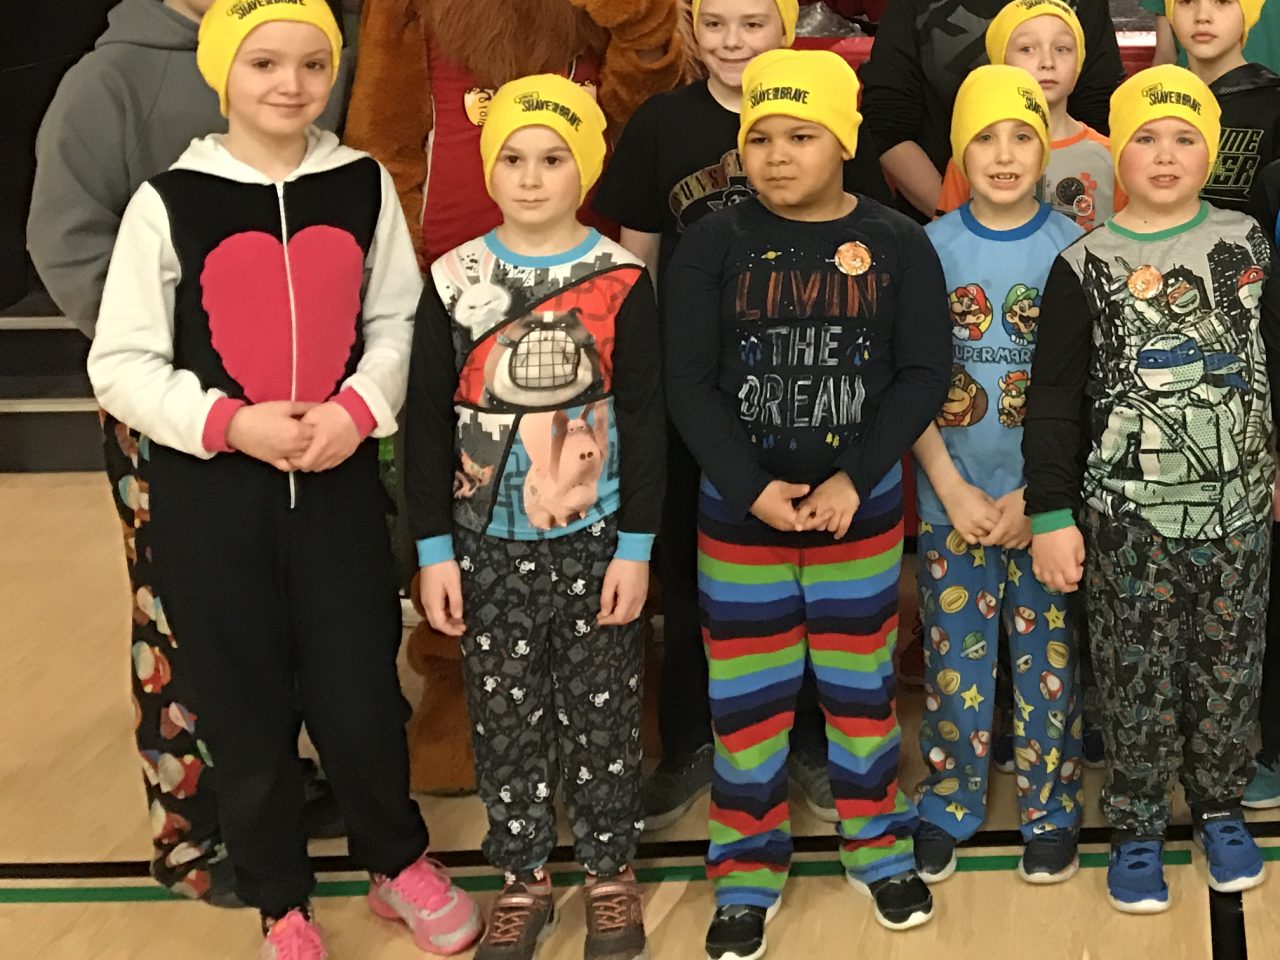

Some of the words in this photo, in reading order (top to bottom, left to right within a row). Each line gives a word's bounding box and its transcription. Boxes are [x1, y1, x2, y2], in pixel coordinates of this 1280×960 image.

[780, 86, 811, 104] BRAVE
[1149, 90, 1174, 106] SHAVE
[522, 99, 551, 112] SHAVE
[766, 325, 843, 367] THE
[954, 345, 993, 362] UPER
[995, 346, 1033, 363] MAR
[737, 373, 866, 427] DREAM
